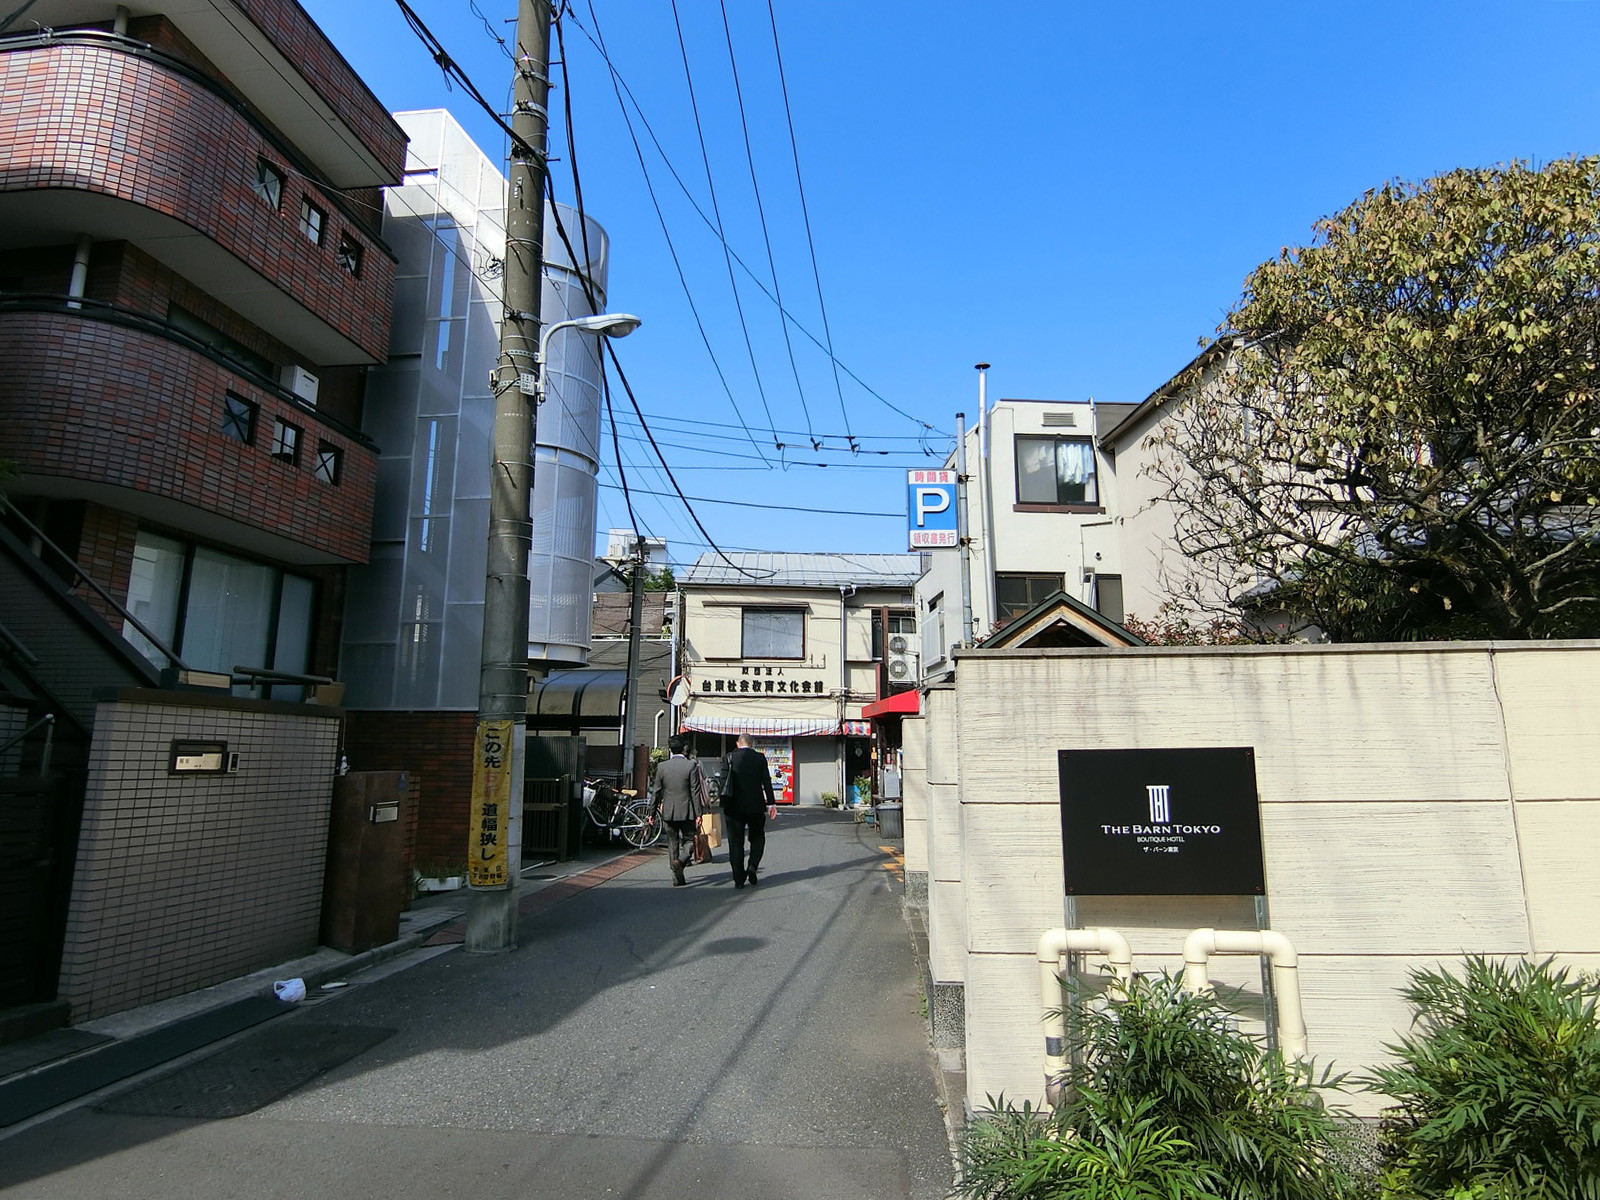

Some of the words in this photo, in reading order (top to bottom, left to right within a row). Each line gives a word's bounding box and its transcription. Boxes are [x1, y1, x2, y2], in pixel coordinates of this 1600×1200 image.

[915, 472, 949, 482] 時間貸
[916, 487, 950, 527] P
[913, 532, 955, 544] 領収書発行
[702, 679, 824, 694] 台東社会教育文化会館
[1100, 824, 1130, 834] THE
[1132, 824, 1171, 834] BARN
[1172, 824, 1221, 834] TOKYO
